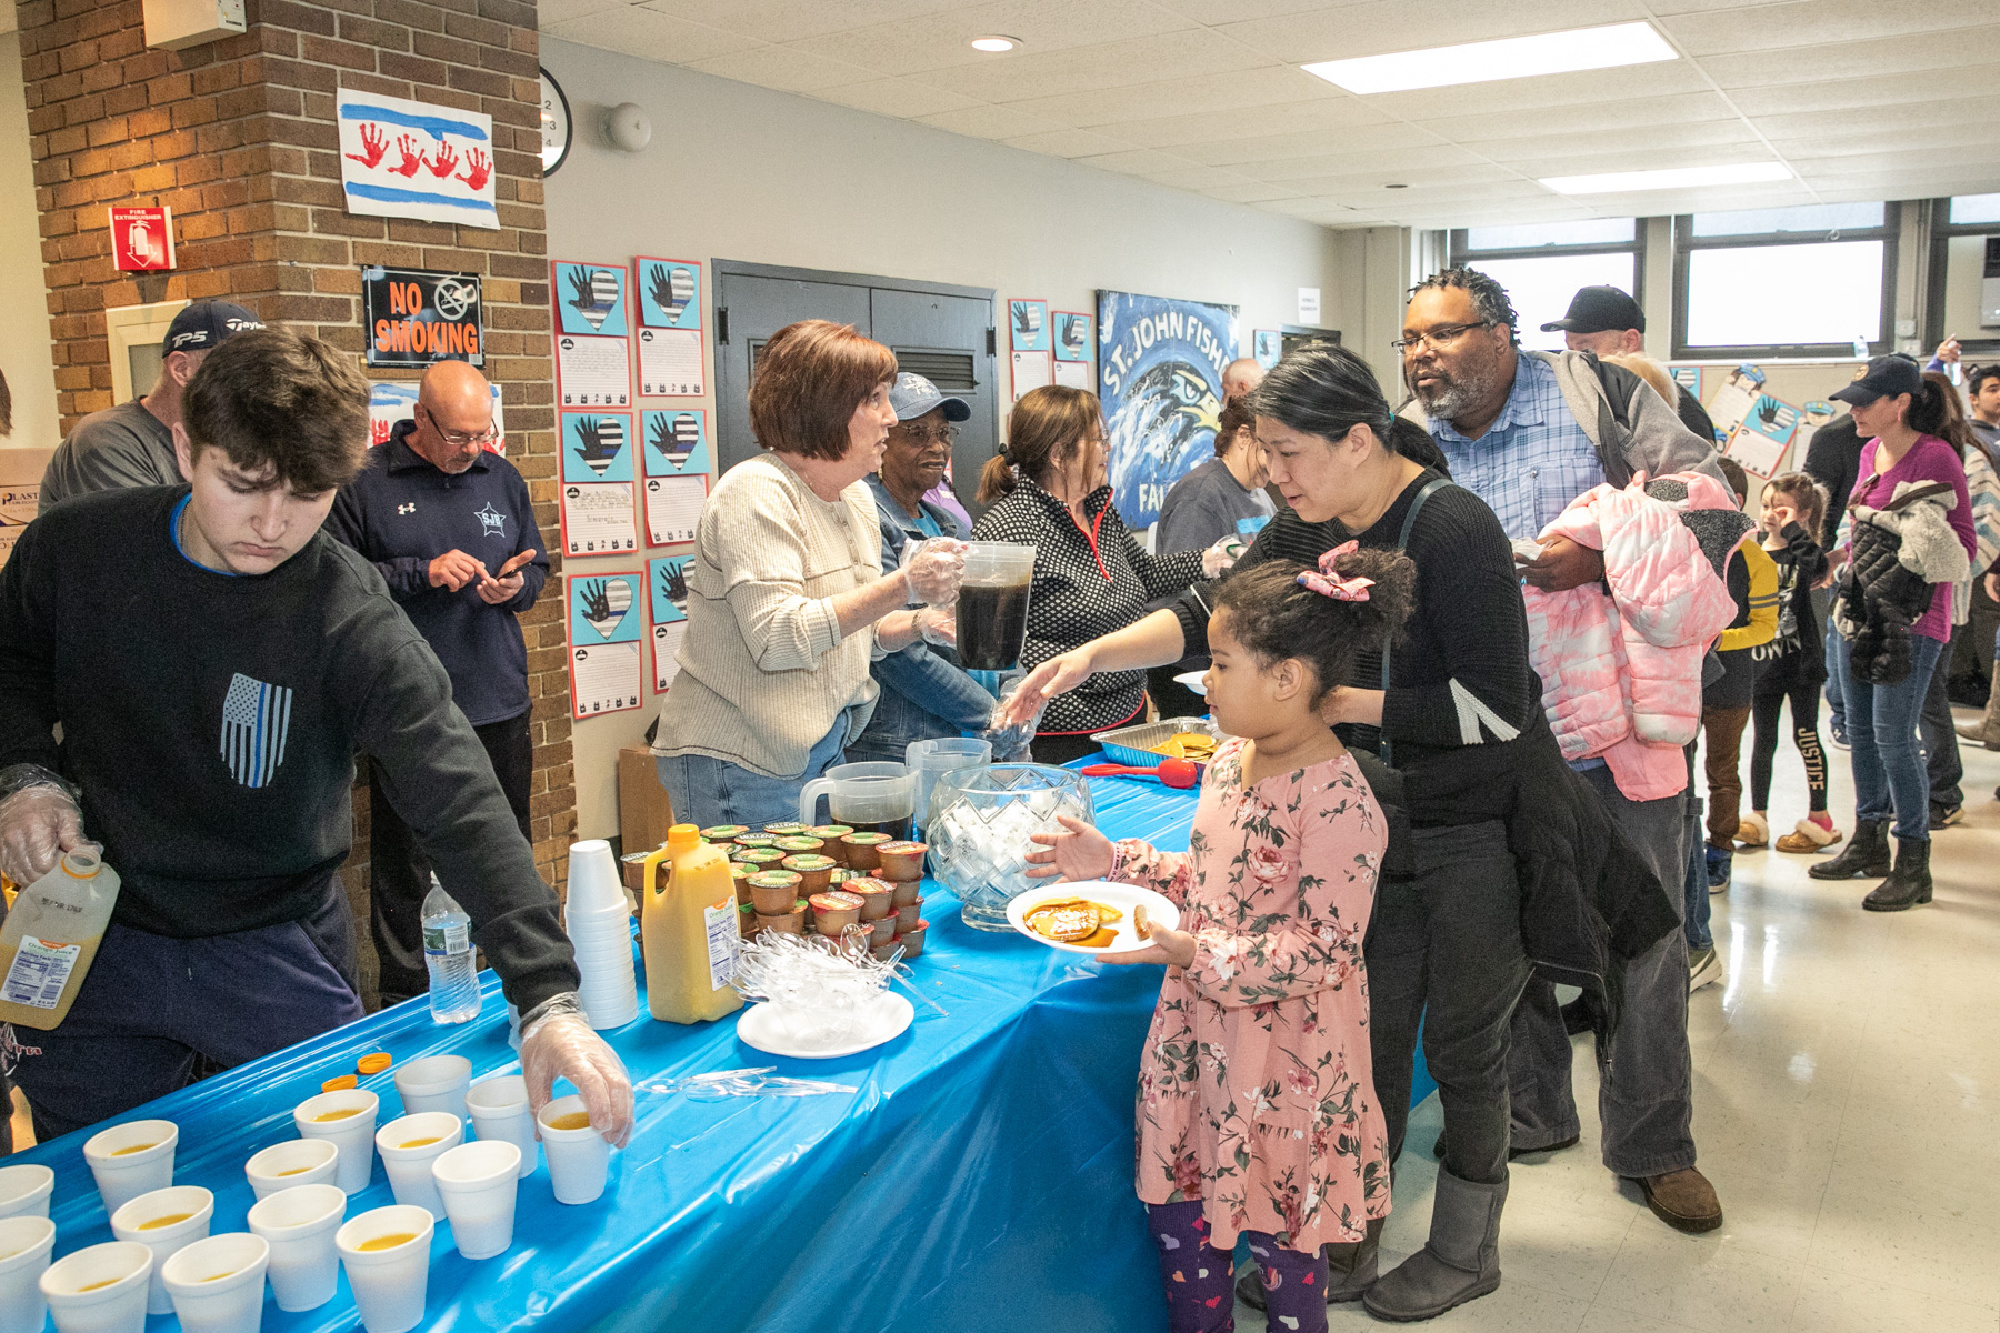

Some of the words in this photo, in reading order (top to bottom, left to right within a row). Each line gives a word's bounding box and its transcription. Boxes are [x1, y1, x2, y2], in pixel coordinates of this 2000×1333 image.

[389, 281, 422, 315] NO
[376, 319, 478, 355] SMOKING
[1103, 344, 1133, 395] ST.
[1130, 311, 1183, 361] JOHN
[1798, 727, 1825, 790] JUSTICE
